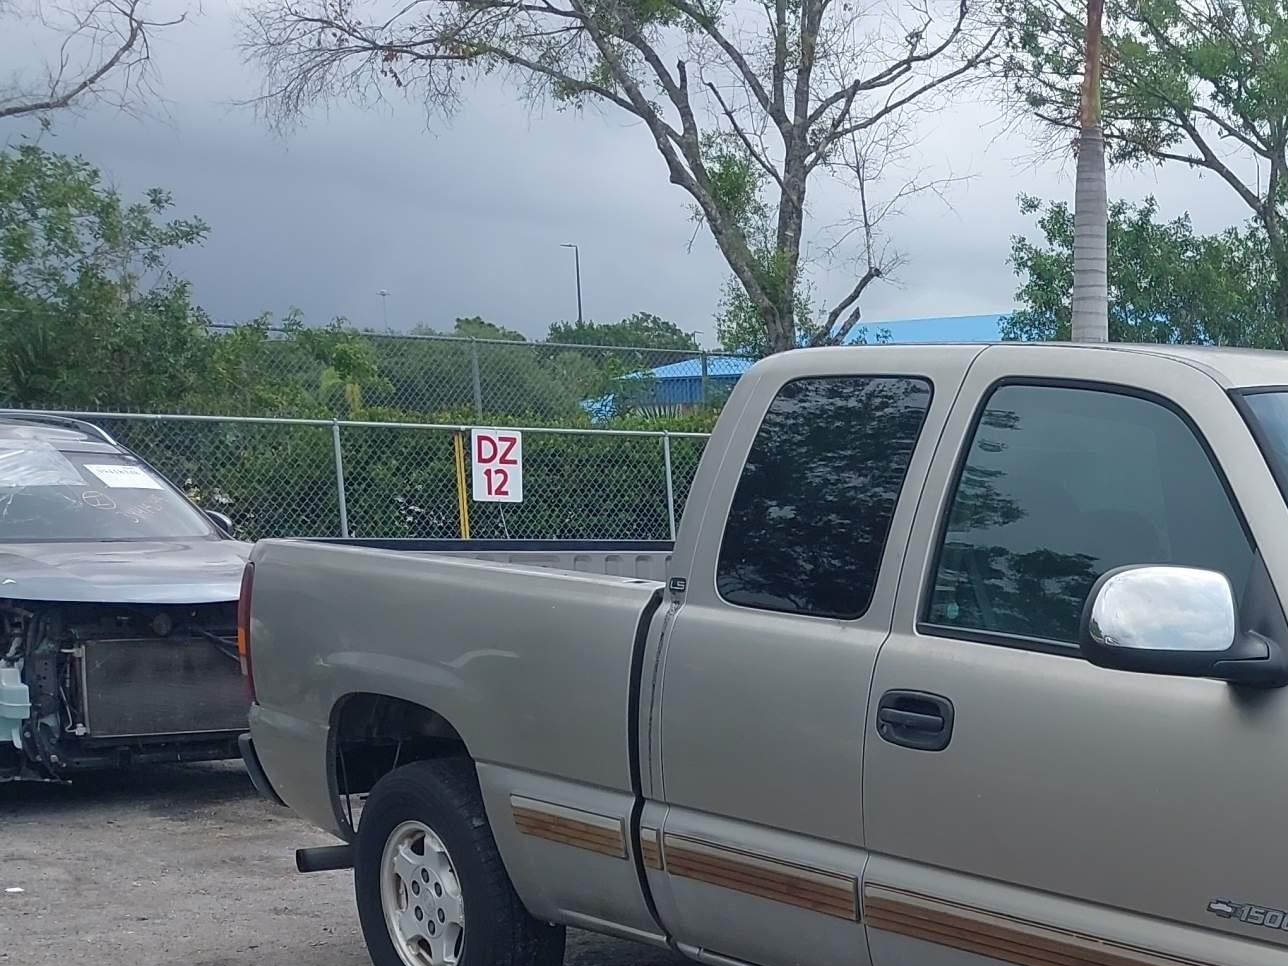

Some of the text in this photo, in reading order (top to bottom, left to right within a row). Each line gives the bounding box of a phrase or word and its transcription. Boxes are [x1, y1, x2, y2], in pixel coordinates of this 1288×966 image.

[477, 435, 518, 465] DZ
[483, 468, 509, 496] 12
[670, 579, 686, 590] LS
